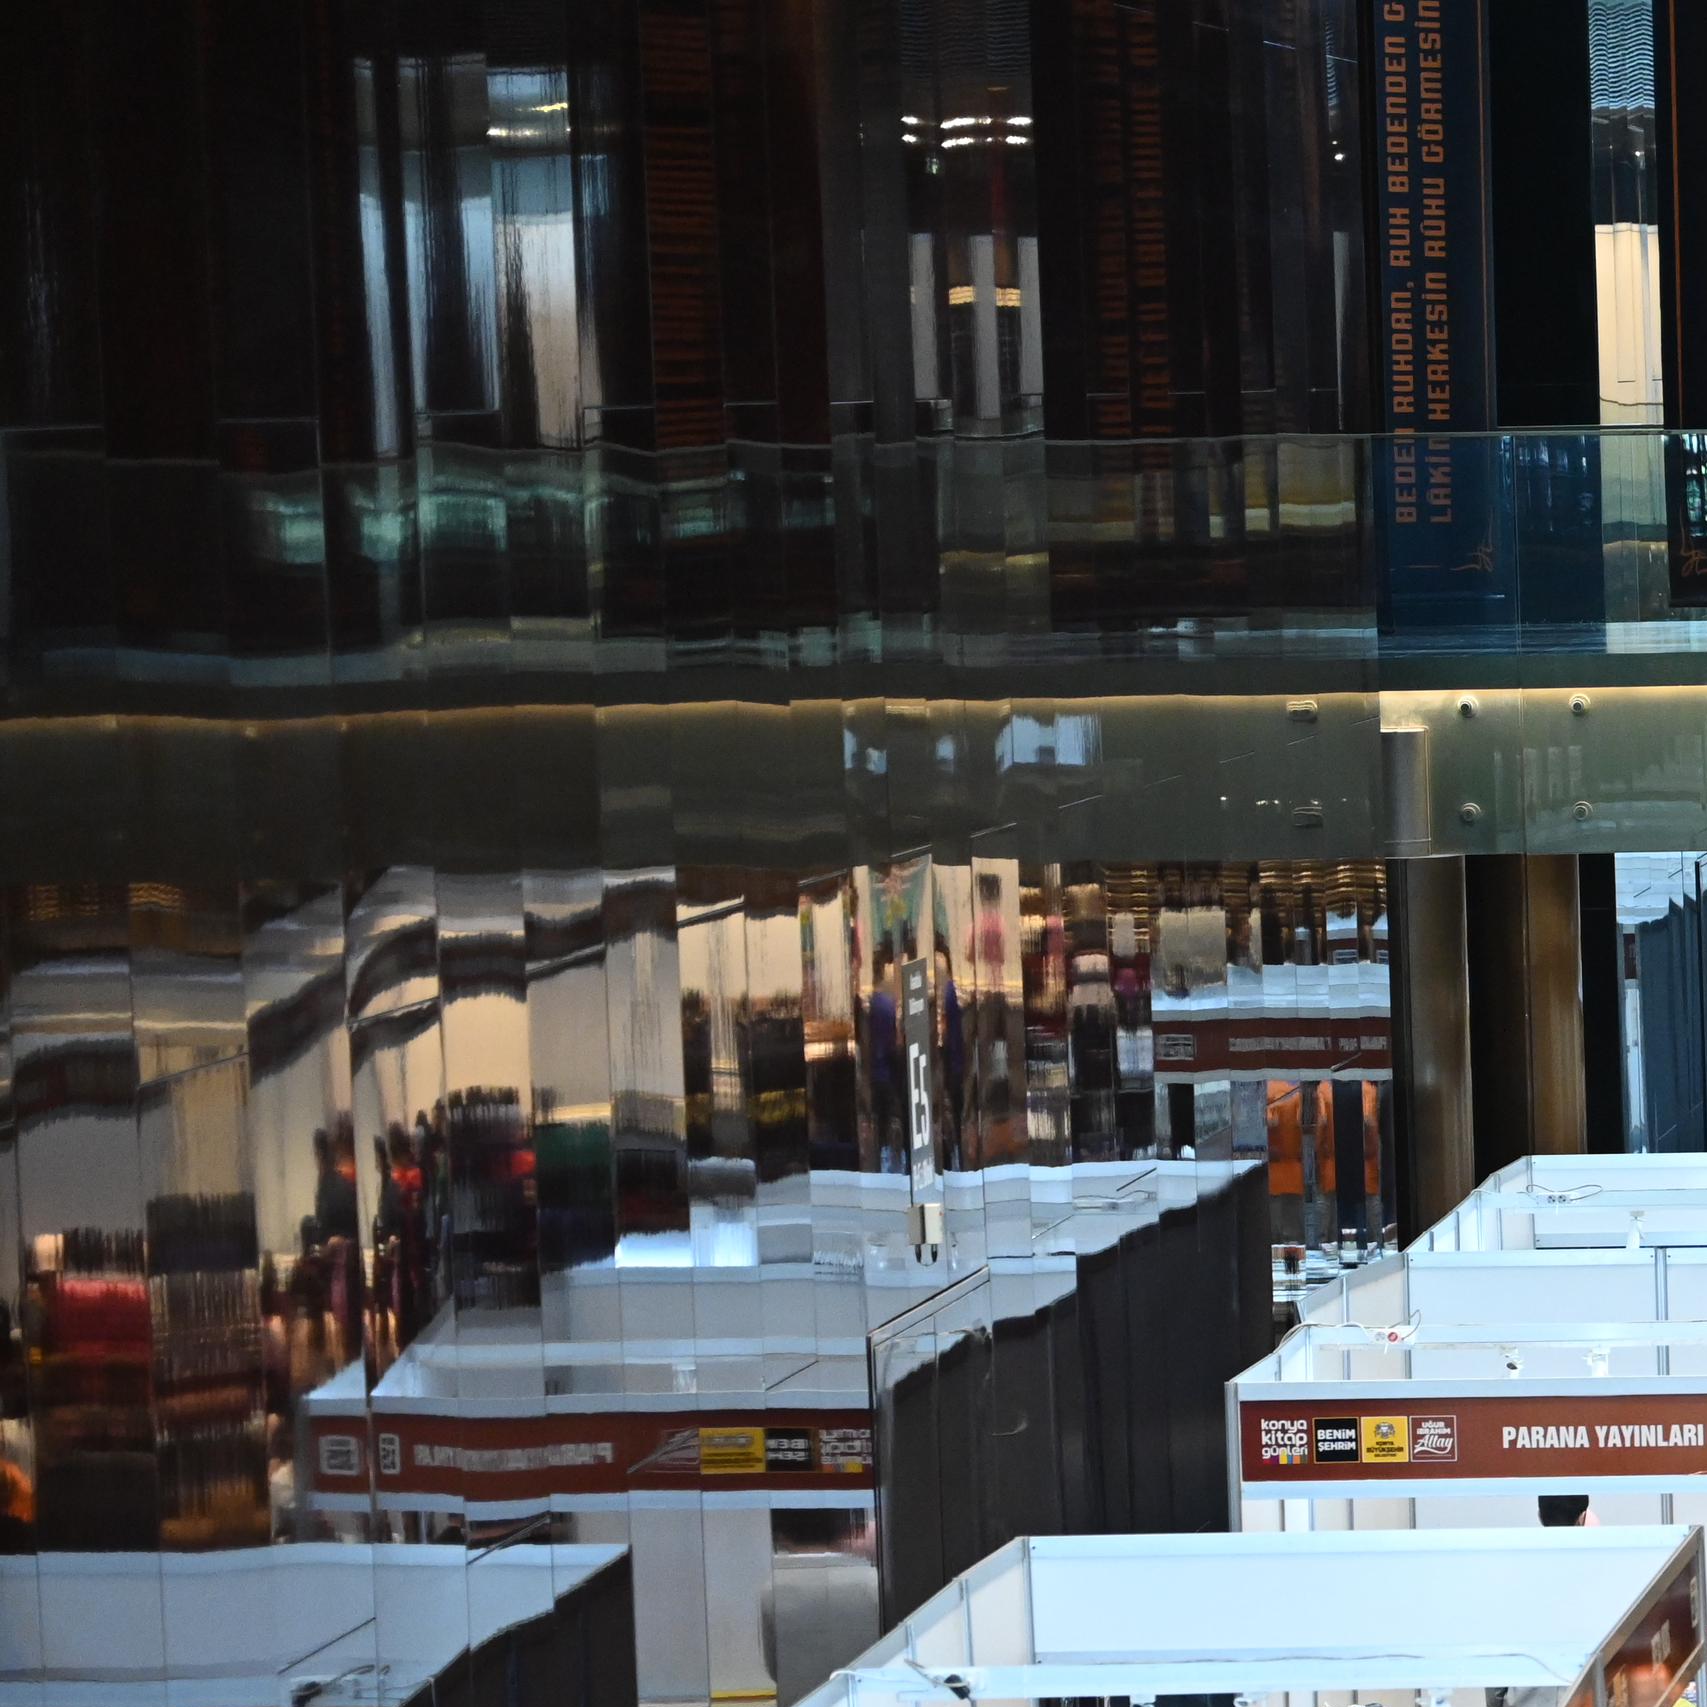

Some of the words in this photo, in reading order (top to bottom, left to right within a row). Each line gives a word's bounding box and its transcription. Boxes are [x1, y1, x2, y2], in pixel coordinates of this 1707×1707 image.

[1384, 36, 1409, 193] BEDENDEN
[1419, 177, 1447, 258] RÛHU
[1388, 207, 1411, 268] RUH
[1390, 281, 1415, 413] RUHDAN,
[1421, 271, 1450, 420] HERKESİN
[1394, 427, 1417, 523] BEDEN
[1261, 1418, 1307, 1434] konya
[1317, 1429, 1356, 1440] BENİM
[1421, 1421, 1445, 1429] UĞUR
[1502, 1426, 1590, 1449] PARANA
[1595, 1424, 1704, 1448] YAYINLARI
[1261, 1431, 1308, 1448] kitap
[1261, 1444, 1308, 1459] günleri
[1317, 1441, 1356, 1453] ŞEHRİM
